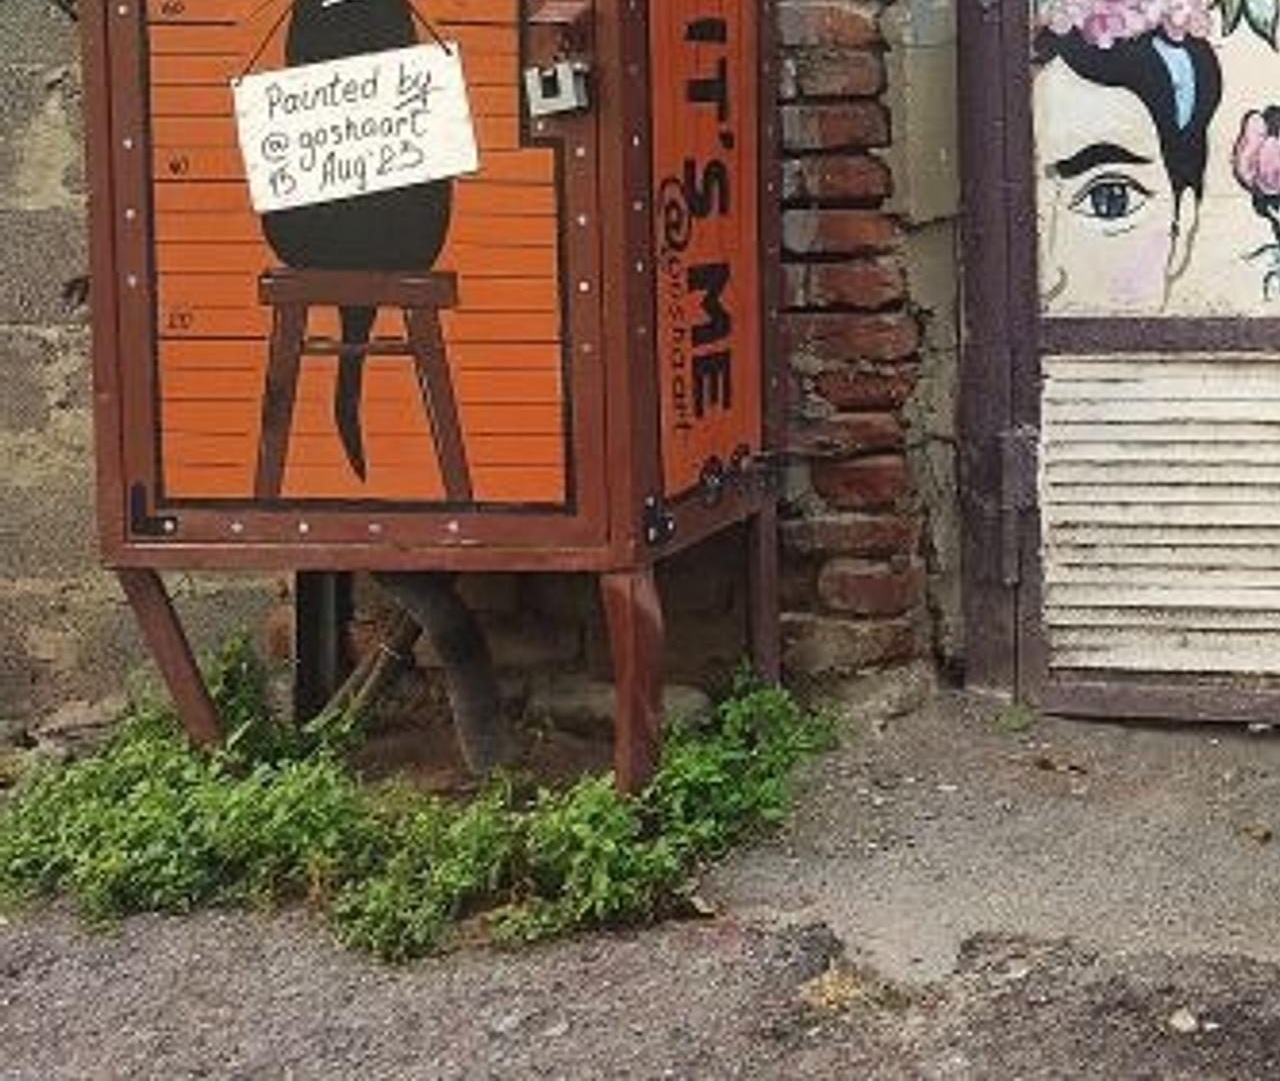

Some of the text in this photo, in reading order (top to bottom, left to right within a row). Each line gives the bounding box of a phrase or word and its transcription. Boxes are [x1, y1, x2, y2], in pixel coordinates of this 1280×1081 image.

[265, 62, 444, 118] Painted by
[687, 262, 733, 418] ME
